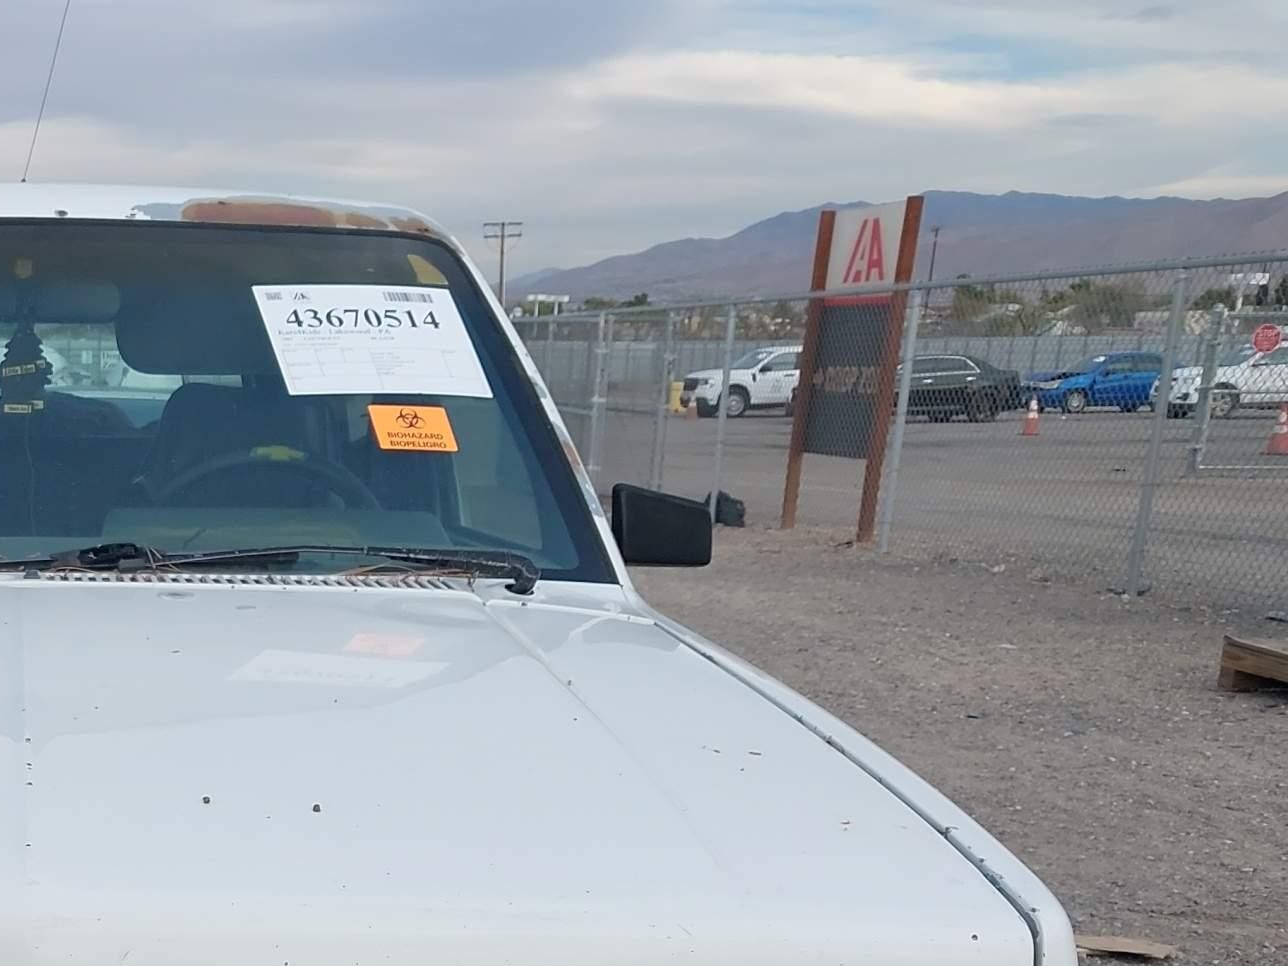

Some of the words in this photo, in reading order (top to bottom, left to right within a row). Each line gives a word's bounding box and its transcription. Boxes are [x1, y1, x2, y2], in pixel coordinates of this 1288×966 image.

[286, 308, 441, 329] 43670514
[387, 431, 444, 440] BIOHAZARD
[390, 440, 447, 448] BIOPELIGRO
